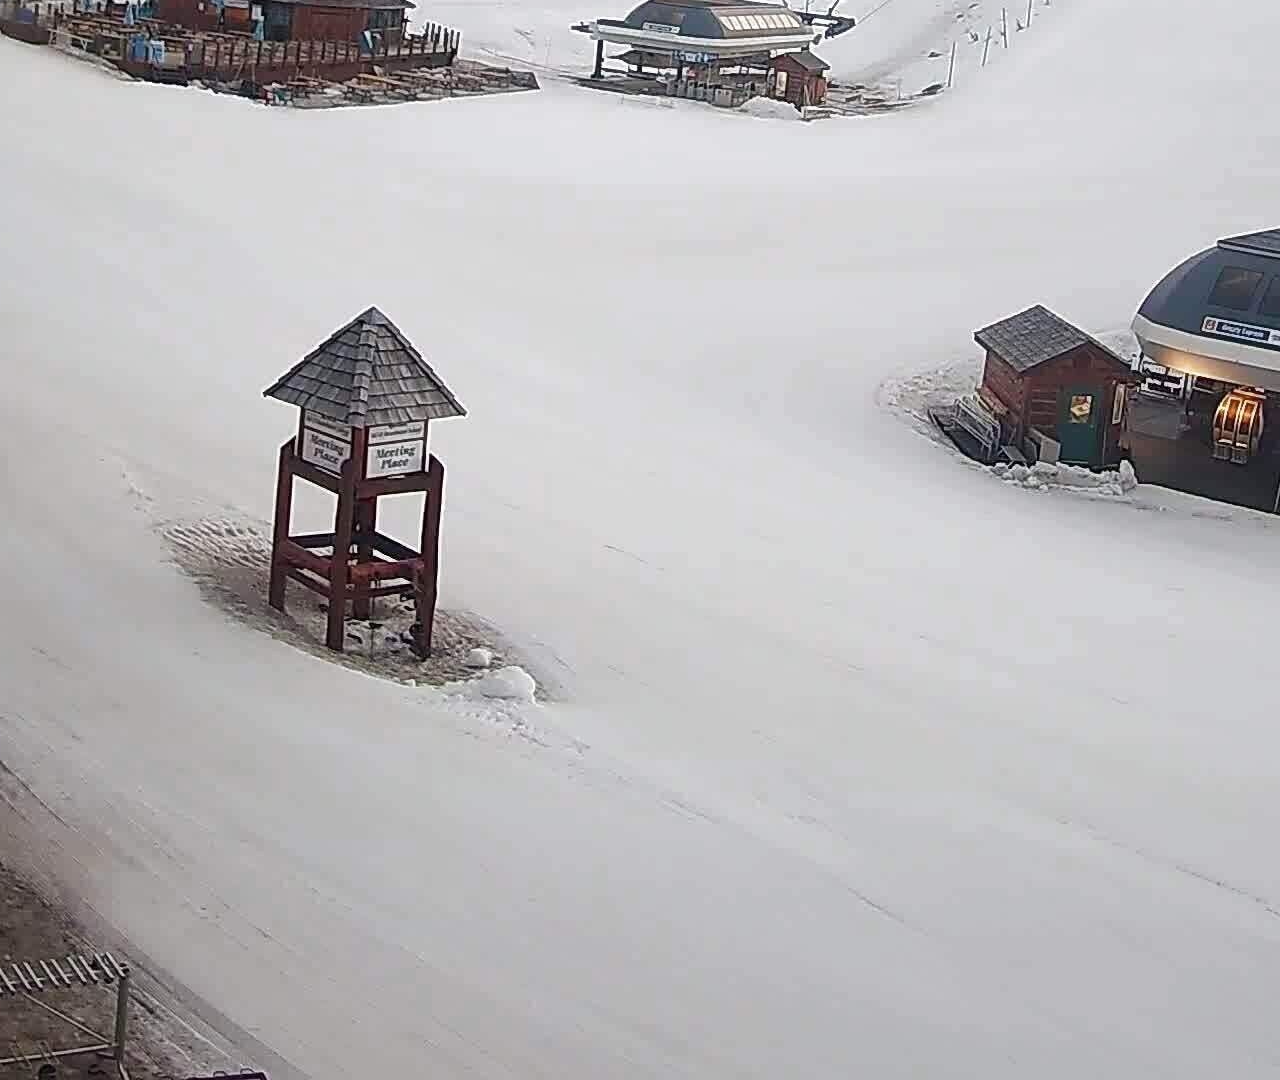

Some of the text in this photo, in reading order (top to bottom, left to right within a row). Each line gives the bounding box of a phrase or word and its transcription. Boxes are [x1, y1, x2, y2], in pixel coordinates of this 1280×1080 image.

[312, 433, 345, 456] Meeting
[376, 445, 417, 459] Meeting
[313, 447, 339, 465] Place
[380, 458, 410, 470] Place
